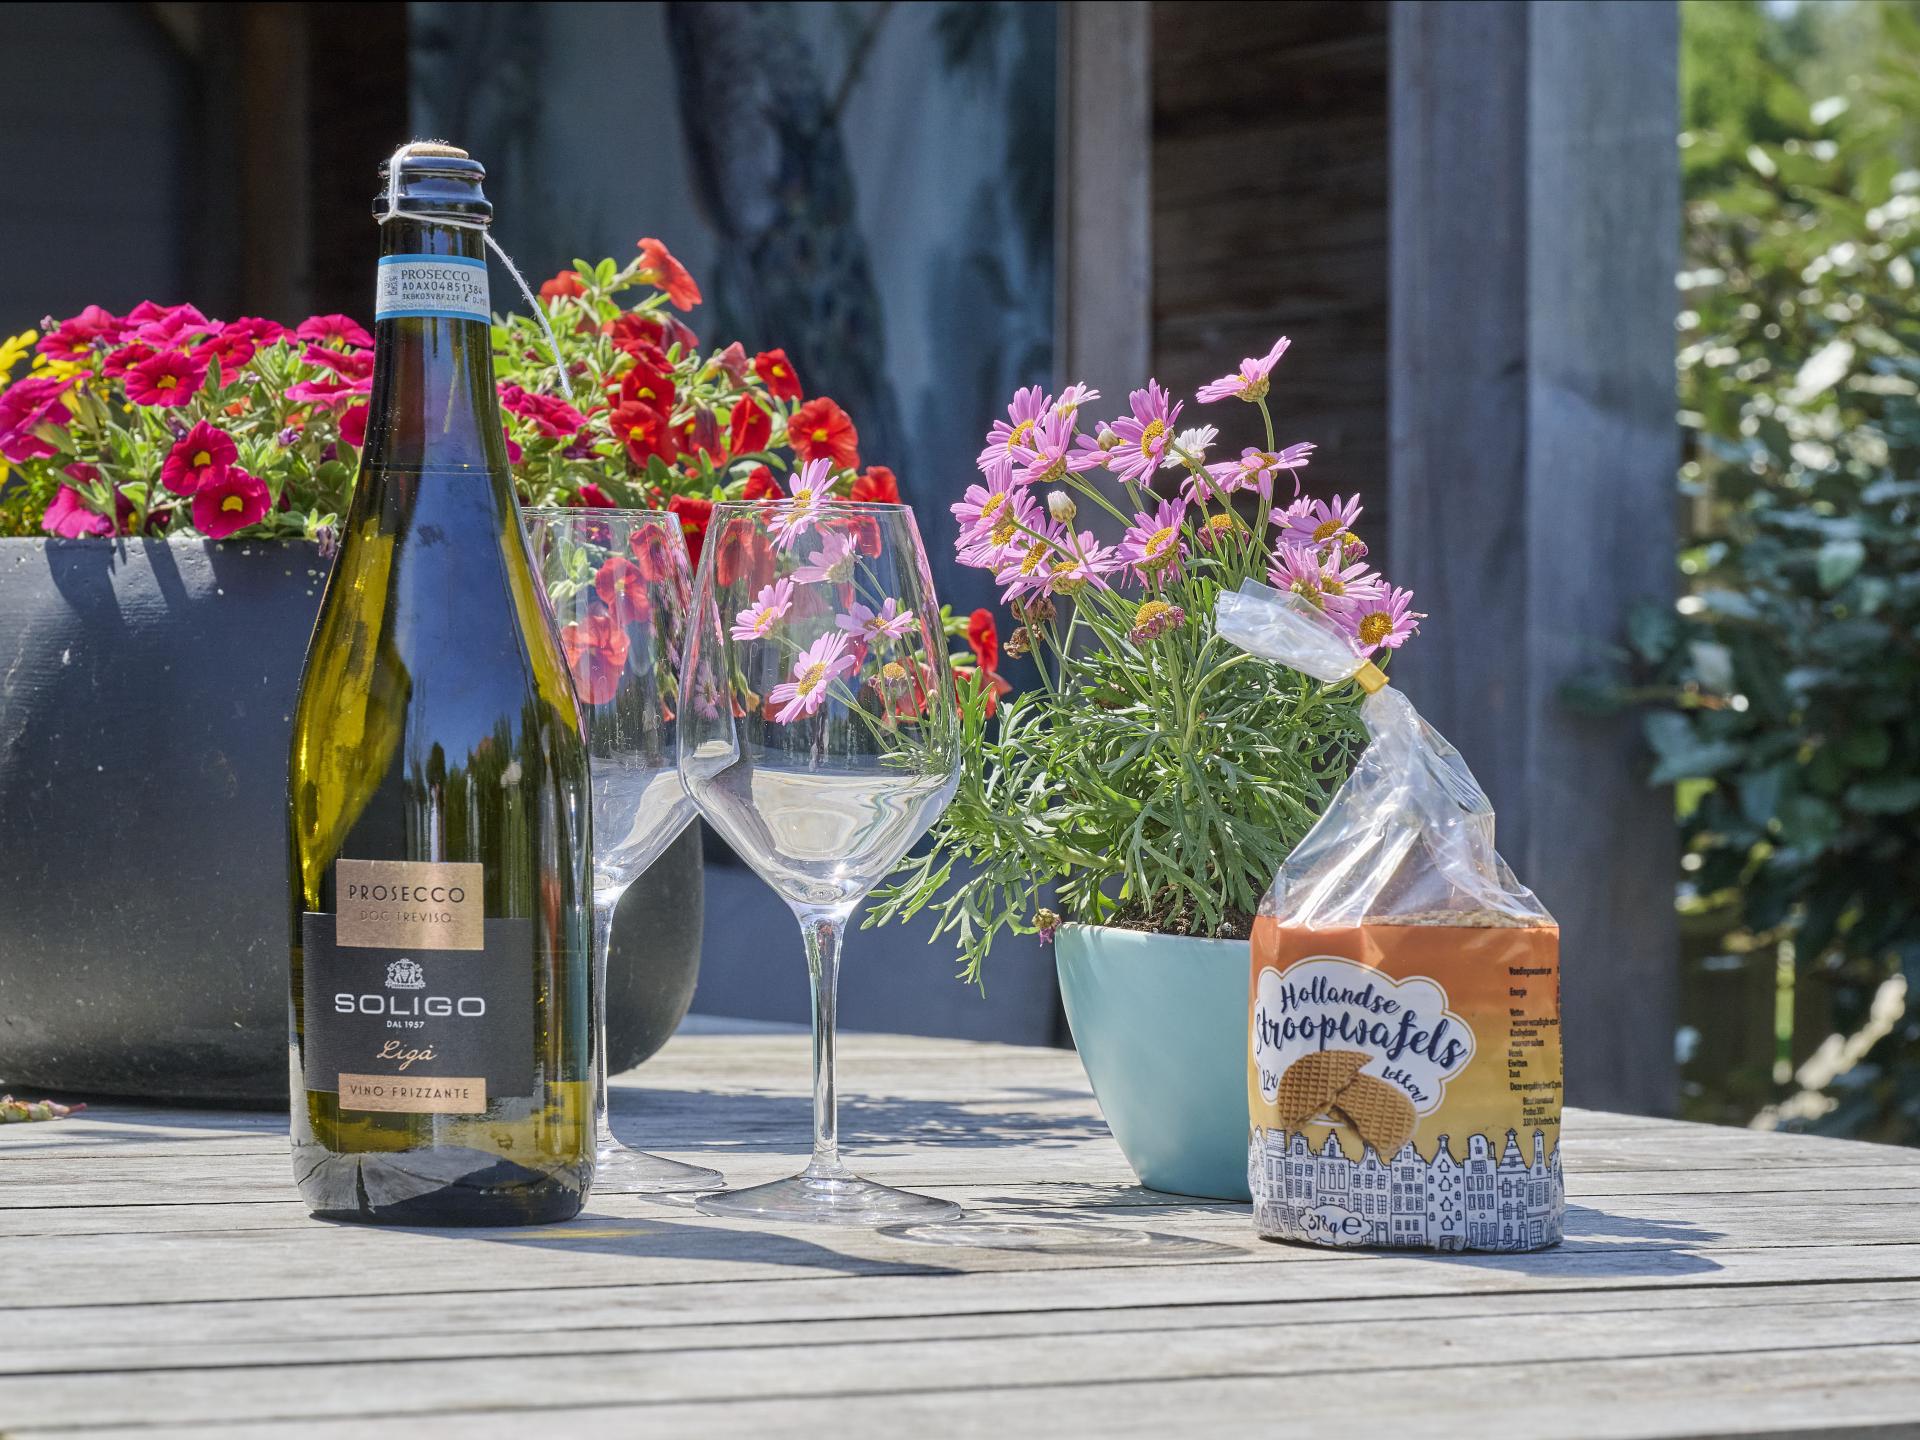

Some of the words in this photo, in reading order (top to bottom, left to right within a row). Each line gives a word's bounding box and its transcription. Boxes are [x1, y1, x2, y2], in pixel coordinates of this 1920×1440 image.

[401, 269, 470, 282] PROSECCO
[349, 885, 465, 903] PROSECCO
[361, 910, 390, 922] DOC
[397, 911, 452, 923] TREVISO
[1280, 975, 1401, 1014] Hollandse
[335, 993, 486, 1017] SOLIGO
[386, 1020, 402, 1029] DAL
[405, 1020, 425, 1029] 1957
[1255, 1006, 1469, 1070] Stroopwafels
[1262, 1069, 1279, 1091] 12x
[1381, 1065, 1429, 1103] Lekker!
[350, 1084, 384, 1097] VINO
[392, 1087, 469, 1099] FRIZZANTE
